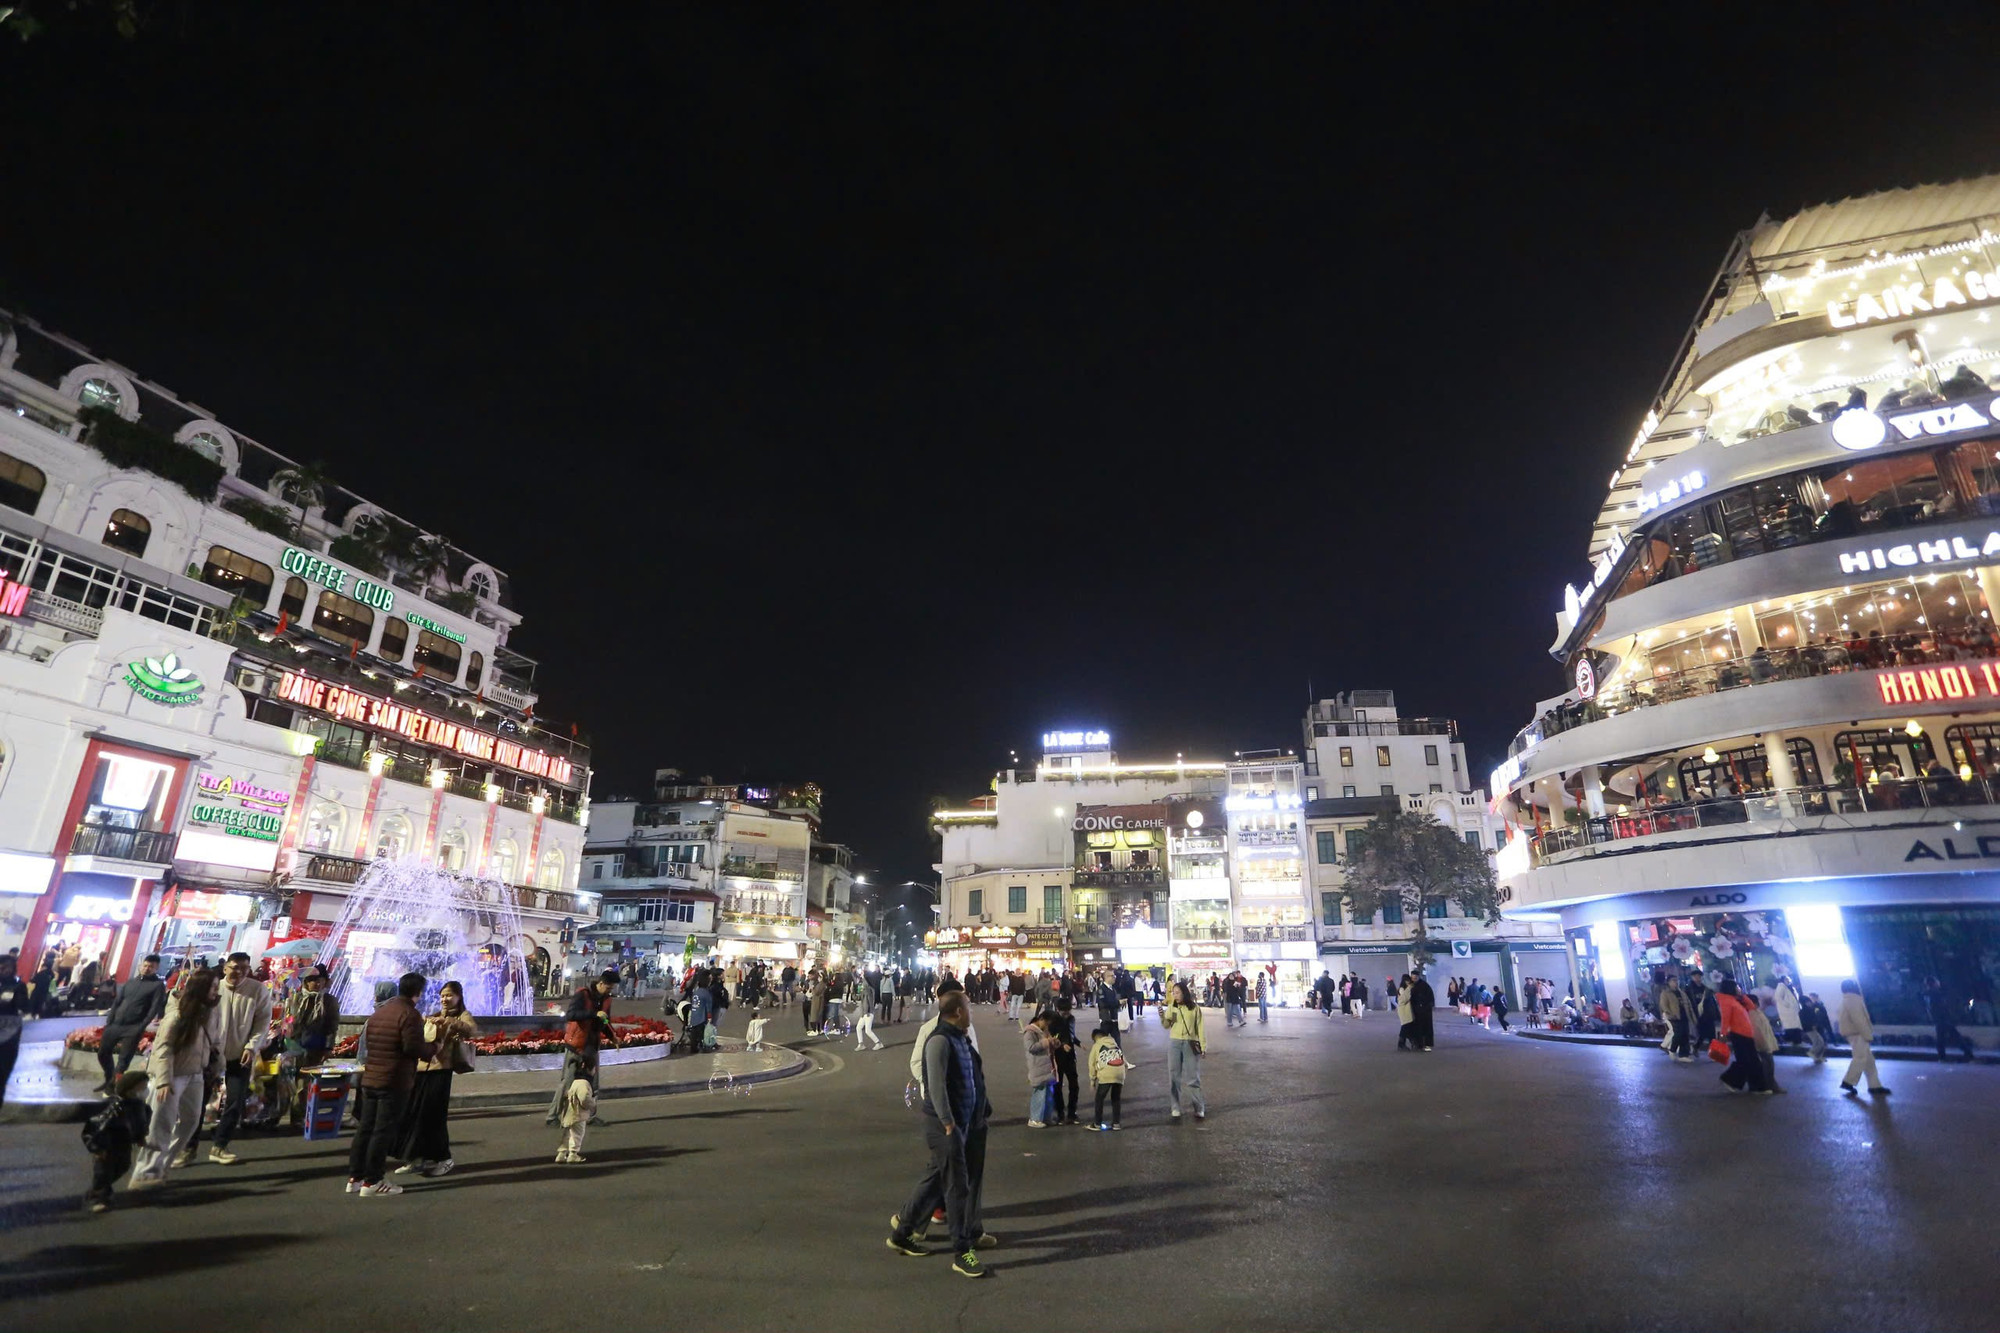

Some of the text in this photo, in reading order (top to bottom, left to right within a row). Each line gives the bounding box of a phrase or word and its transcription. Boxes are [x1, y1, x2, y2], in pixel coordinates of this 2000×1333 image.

[1826, 277, 1967, 329] LAIKA
[282, 548, 395, 612] COFFEE CLUB
[432, 623, 467, 644] Restaurant
[1878, 665, 1976, 704] HANOI
[278, 668, 572, 784] ĐẢNG CỘNG SẢN VIỆT NAM QUANG VINH MUÔN NĂM
[193, 804, 245, 827] COFFEE
[248, 813, 280, 832] CLUB
[1690, 893, 1747, 907] ALDO
